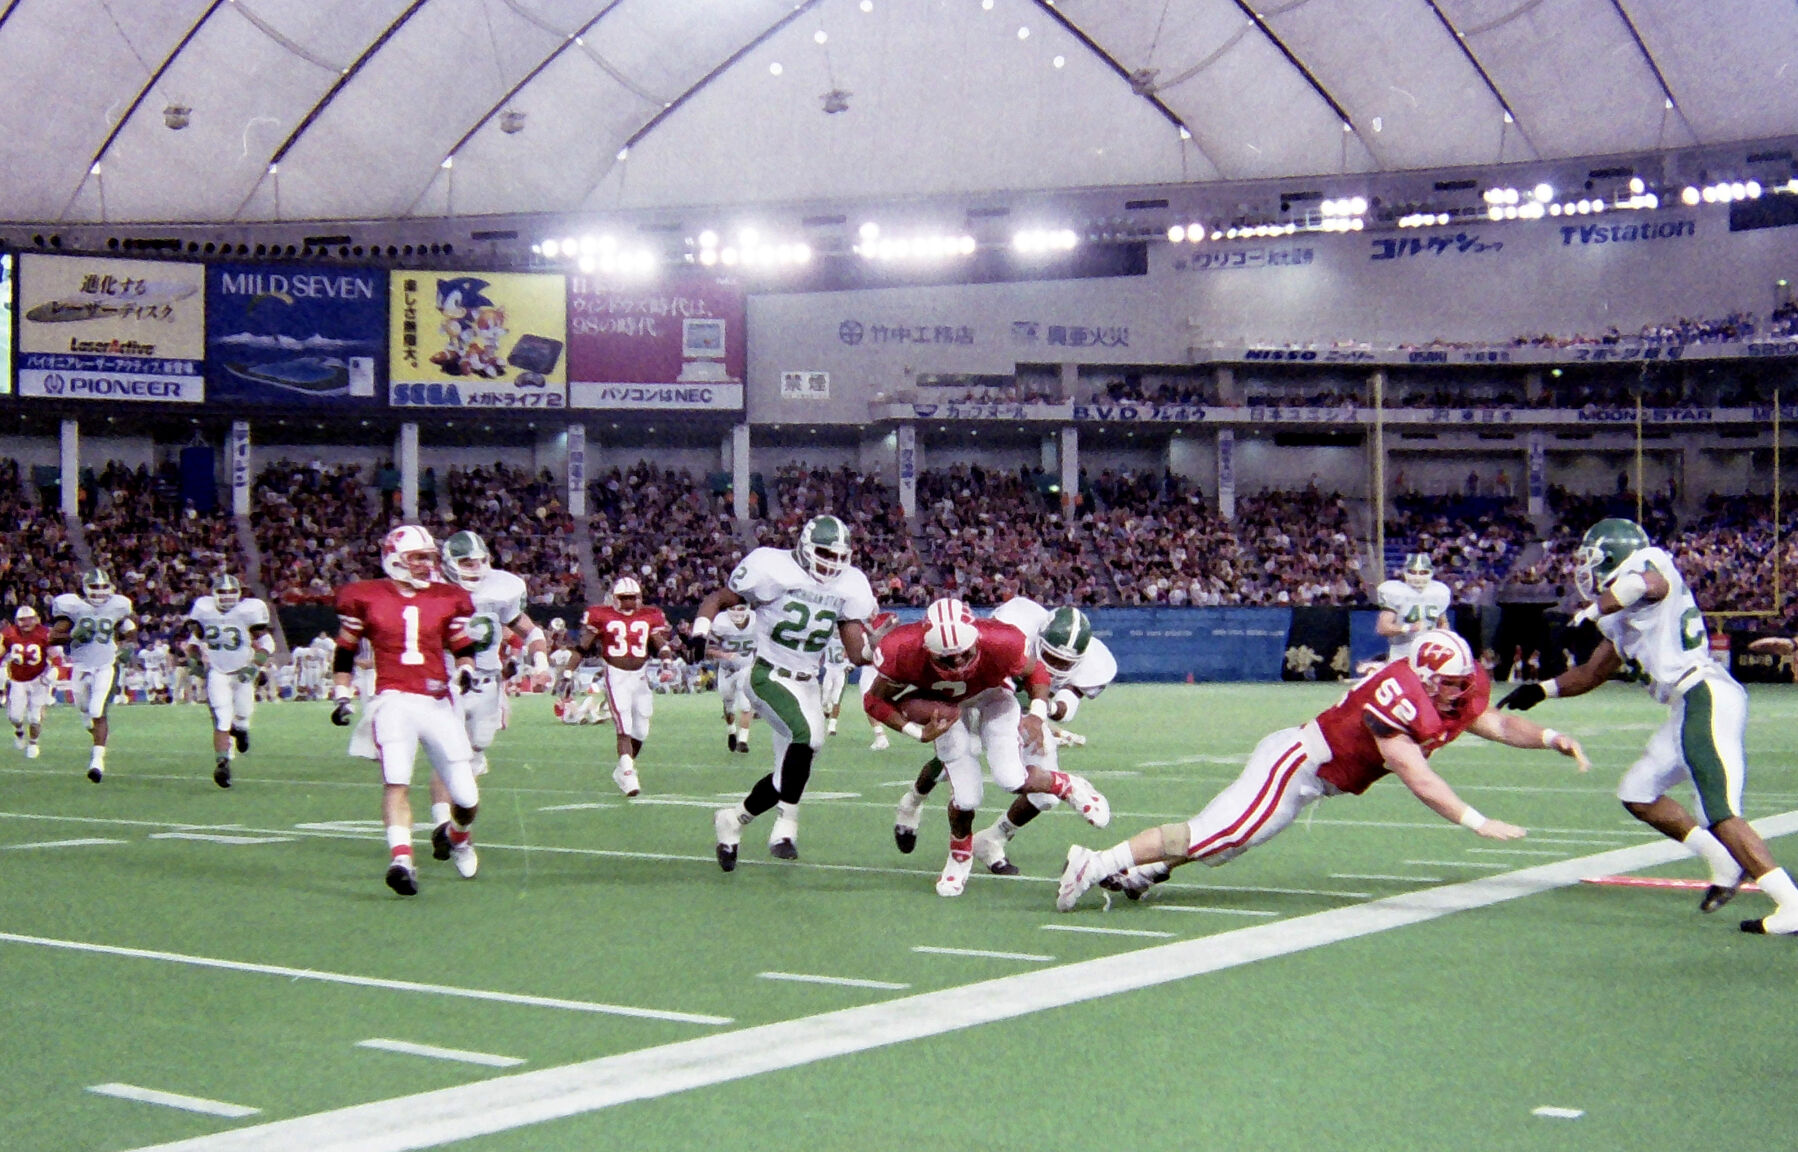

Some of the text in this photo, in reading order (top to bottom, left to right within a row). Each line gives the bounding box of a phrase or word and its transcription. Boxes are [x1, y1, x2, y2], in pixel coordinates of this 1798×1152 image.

[1559, 220, 1695, 245] TVstation
[79, 273, 146, 296] 進化する
[222, 272, 374, 299] MILD SEVEN
[1245, 349, 1317, 361] NISSO
[70, 377, 181, 397] PIONEER
[393, 383, 462, 405] SEGA
[467, 392, 563, 406] メガドライブ2
[600, 387, 713, 404] パソコンはNEC
[204, 625, 242, 650] 23
[401, 605, 424, 665] 1
[606, 620, 649, 658] 33
[770, 600, 836, 653] 22
[1375, 677, 1417, 722] 52
